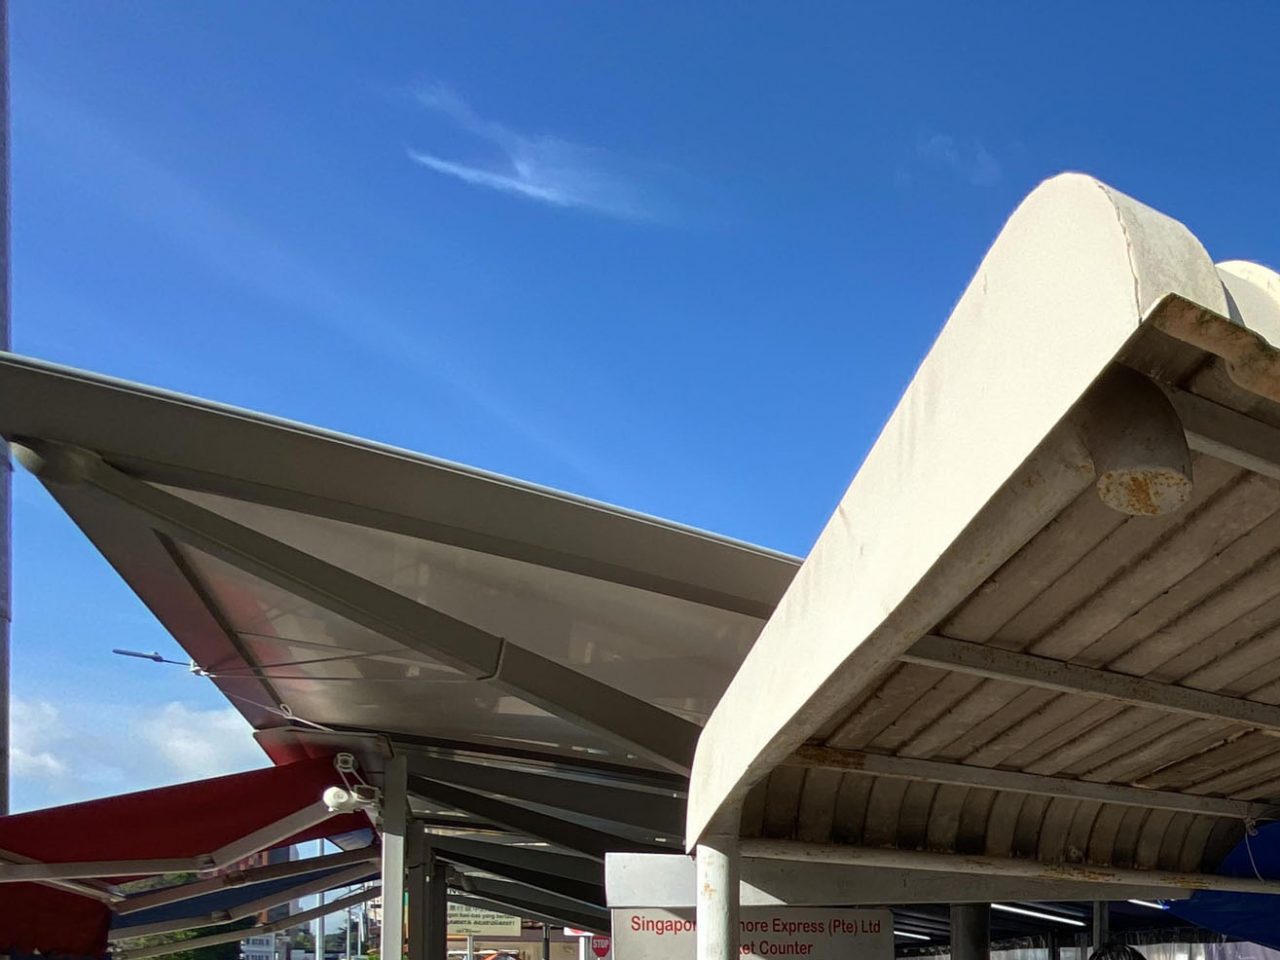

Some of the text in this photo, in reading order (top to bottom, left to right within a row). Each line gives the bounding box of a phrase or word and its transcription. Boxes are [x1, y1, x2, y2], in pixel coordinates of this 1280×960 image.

[631, 915, 697, 935] Singapor
[772, 918, 825, 936] Express
[828, 919, 858, 936] (Pte)
[861, 919, 881, 934] Ltd
[592, 939, 609, 949] STOP
[759, 940, 814, 955] Counter
